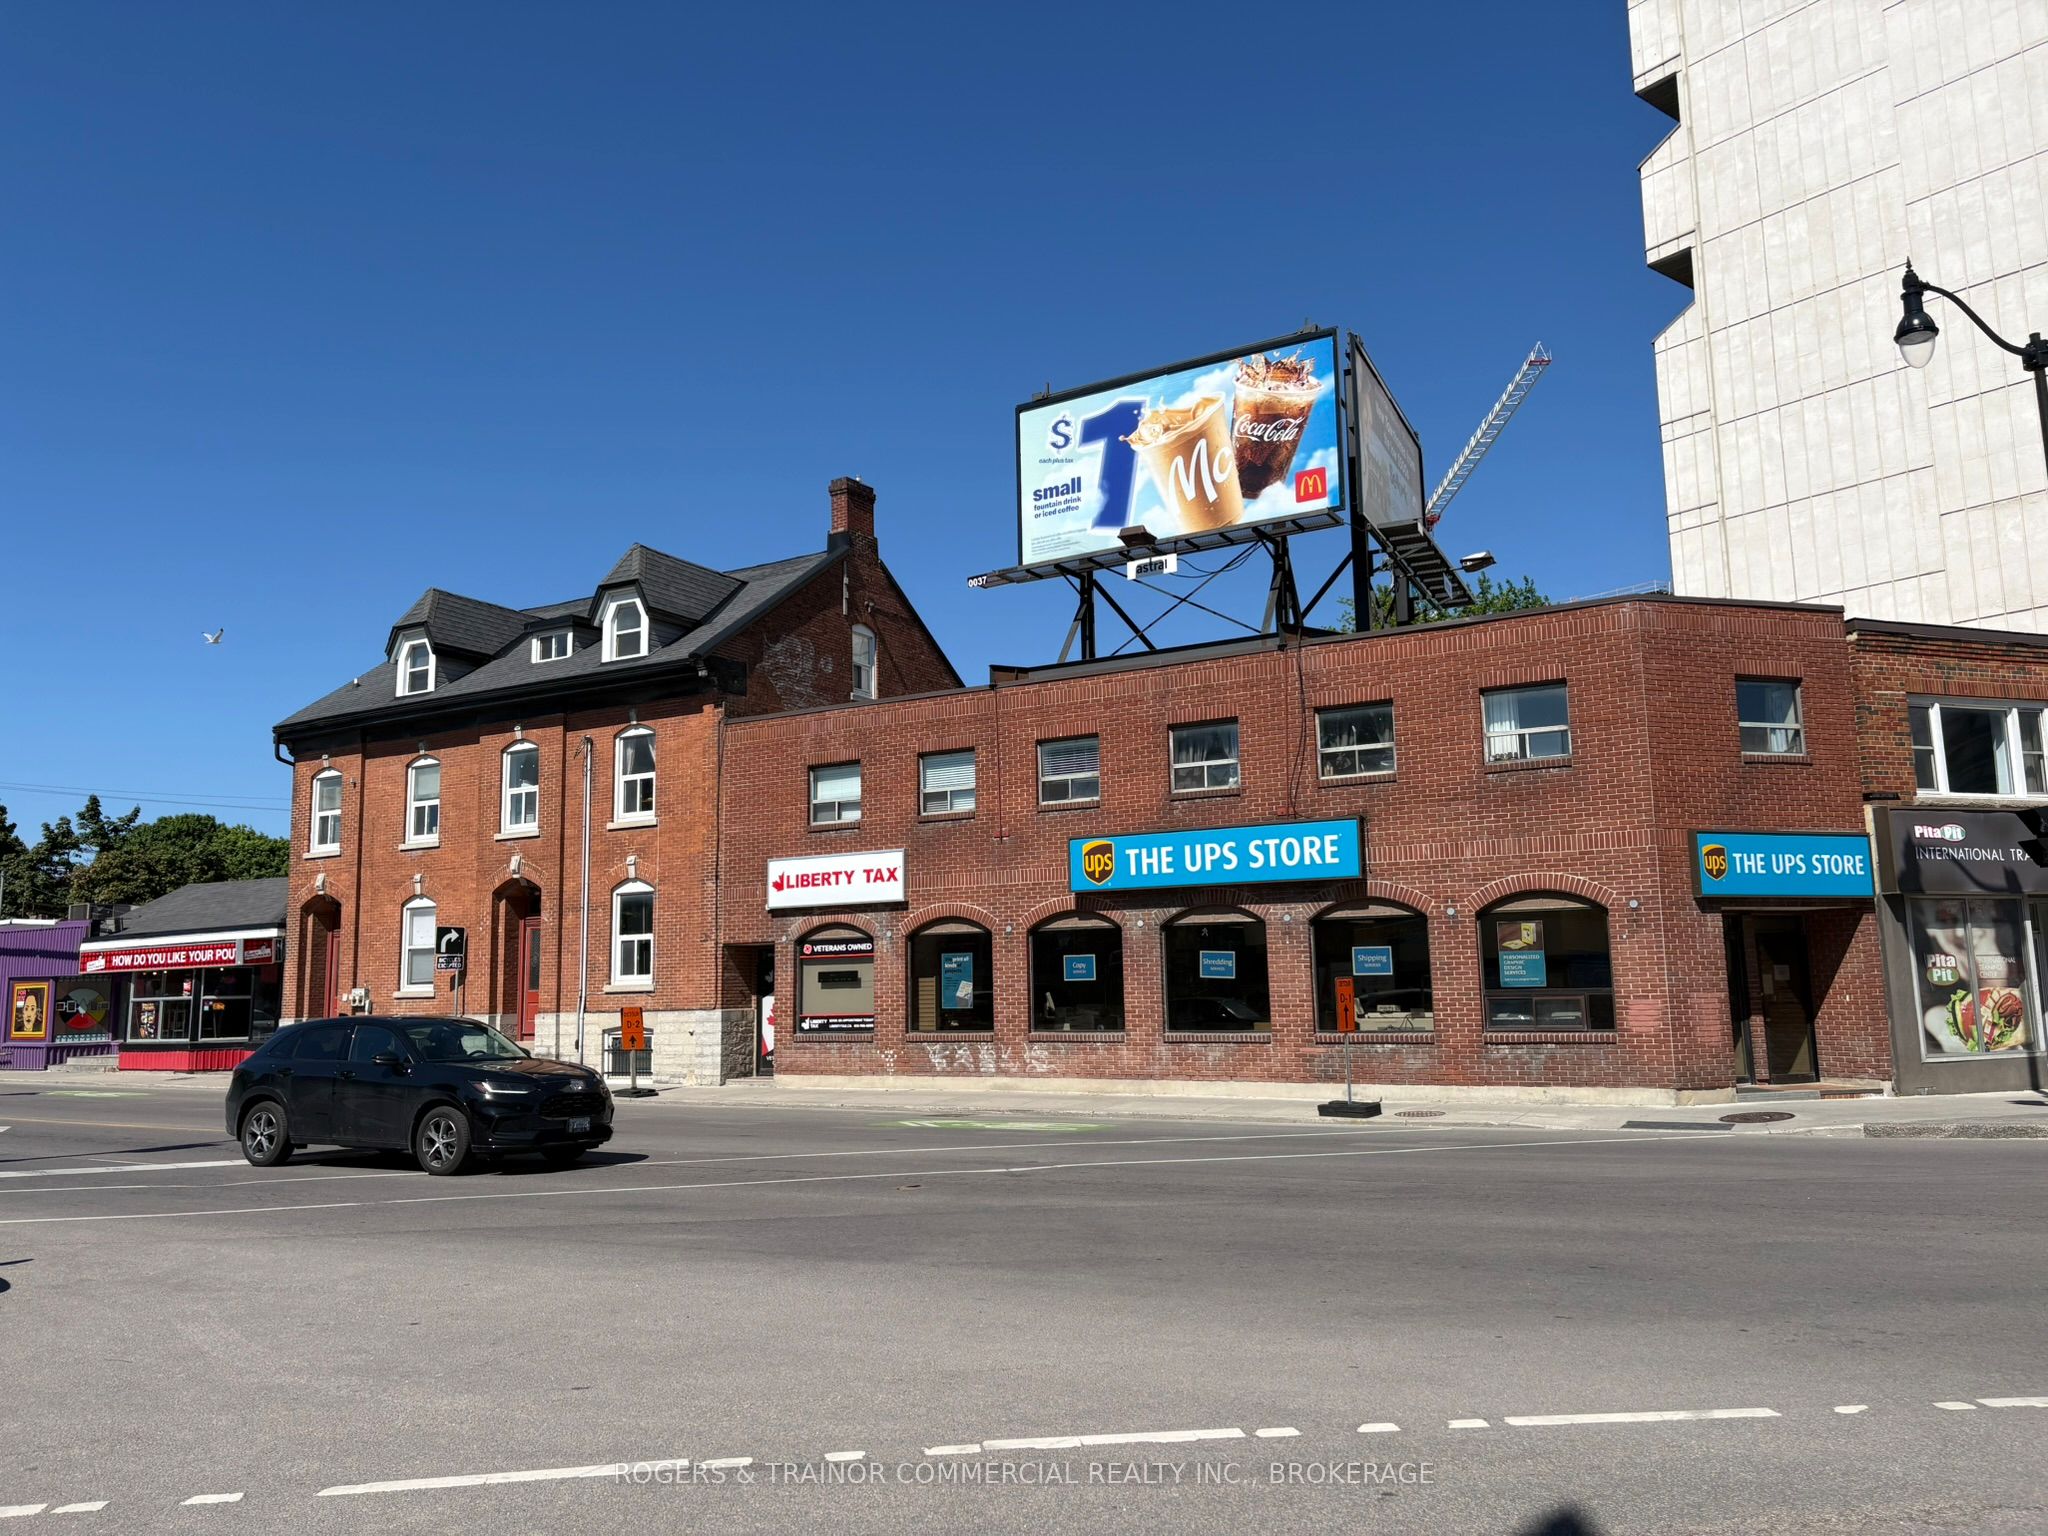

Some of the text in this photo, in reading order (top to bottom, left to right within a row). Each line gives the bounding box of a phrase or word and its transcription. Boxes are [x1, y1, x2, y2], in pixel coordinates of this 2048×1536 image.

[1235, 413, 1305, 442] Coca-Cola
[1168, 438, 1233, 504] Mc
[1033, 476, 1082, 502] small
[1034, 496, 1082, 511] fountain drink
[1042, 508, 1056, 517] iced
[1057, 505, 1079, 514] coffee
[1136, 559, 1167, 574] astral
[968, 576, 987, 588] 0037
[1914, 825, 1963, 839] Pita Pit
[1085, 834, 1340, 878] ups THE UPS STORE
[1915, 847, 2005, 861] INTERNATIONAL
[1704, 853, 1865, 875] ups THE UPS STORE
[786, 867, 898, 889] LIBERTY TAX
[813, 943, 872, 952] VETERANS OWNED
[112, 955, 132, 967] HOW
[134, 954, 146, 965] DO
[147, 953, 166, 965] YOU
[167, 952, 186, 964] LIKE
[189, 950, 214, 962] YOUR
[215, 948, 237, 961] POU
[1358, 954, 1387, 963] Shipping
[1927, 953, 1956, 967] Pita
[1072, 961, 1086, 969] Copy
[1932, 969, 1954, 981] Pit
